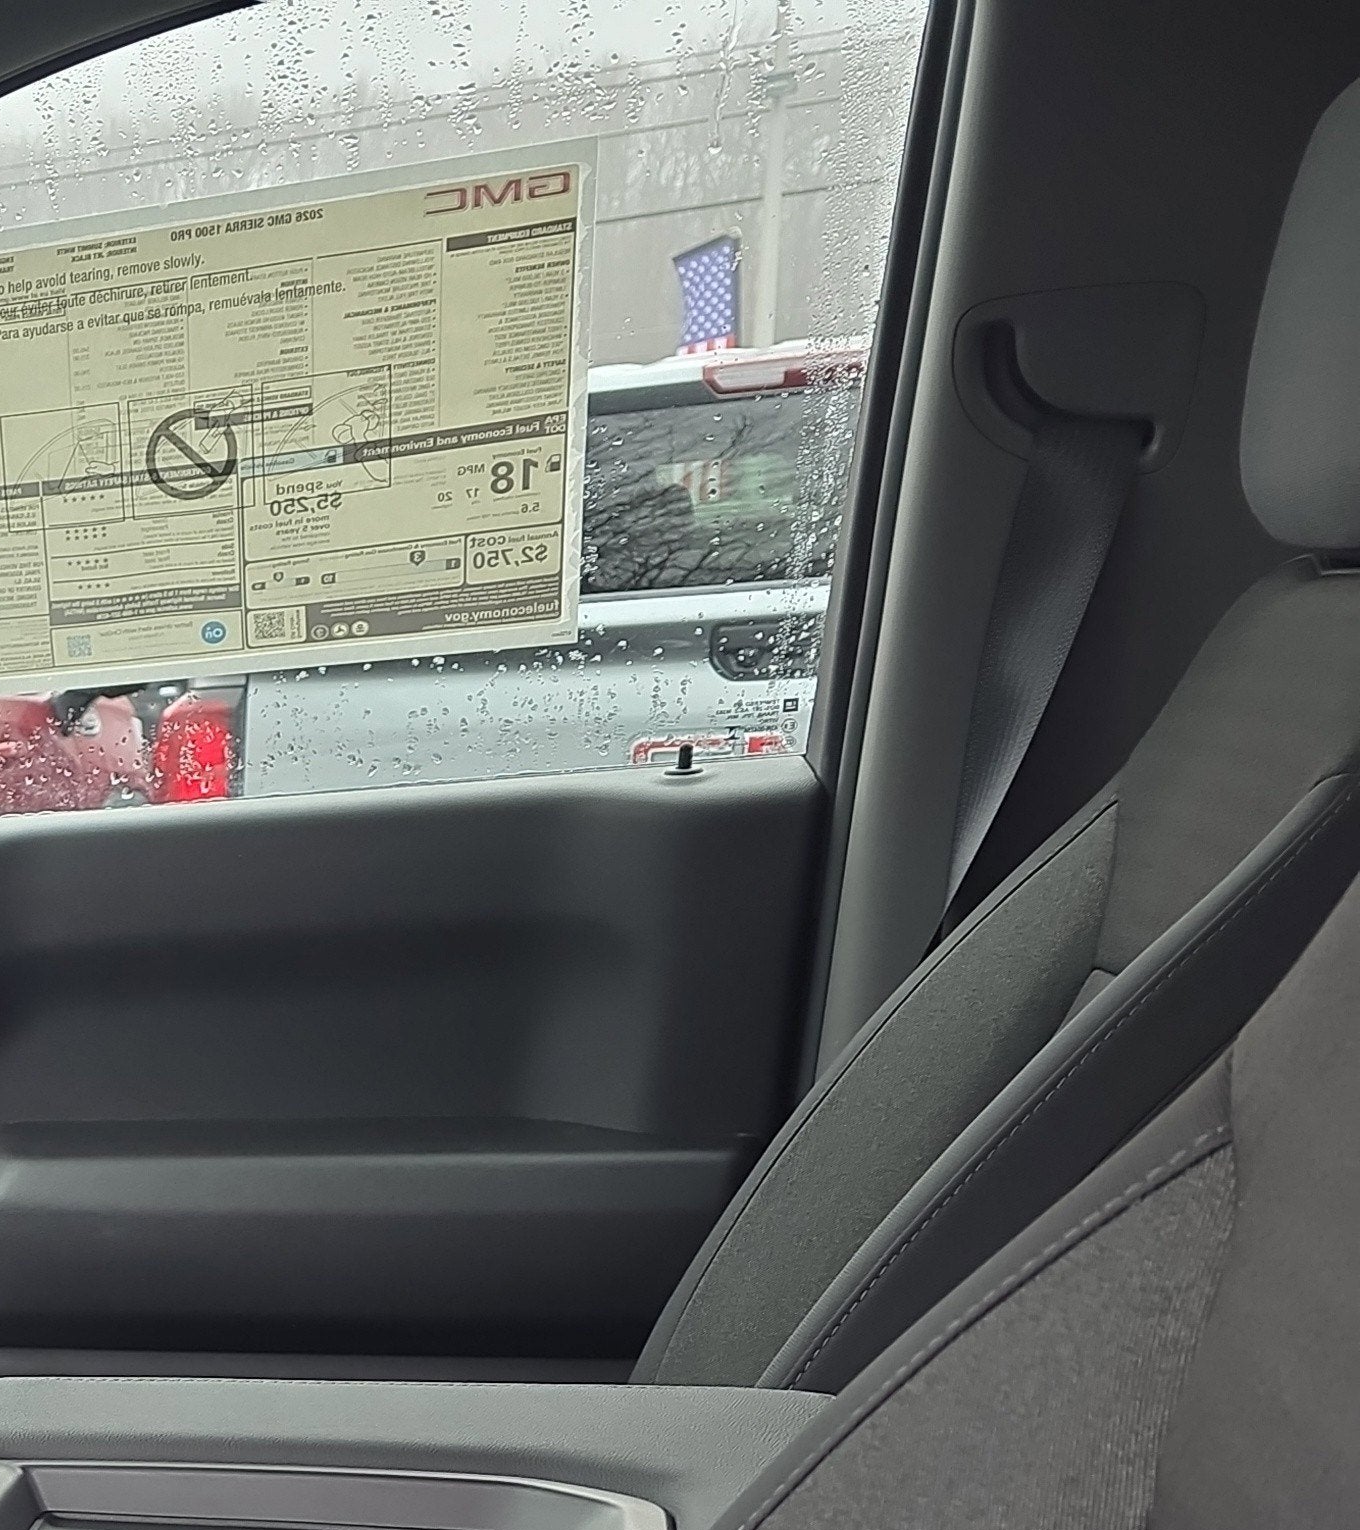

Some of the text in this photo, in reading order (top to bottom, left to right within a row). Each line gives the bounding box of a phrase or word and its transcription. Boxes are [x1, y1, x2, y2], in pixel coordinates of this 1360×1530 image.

[6, 277, 33, 295] help
[34, 272, 66, 289] avoid
[69, 266, 114, 286] tearing,
[116, 259, 160, 277] remove
[162, 251, 205, 272] slowly.
[20, 298, 53, 315] éviter
[56, 294, 86, 309] toute
[88, 285, 147, 306] déchirure,
[149, 278, 186, 295] retirer
[189, 268, 253, 289] lentement.
[21, 319, 74, 340] ayudarse
[86, 311, 120, 328] evitar
[121, 310, 144, 325] que
[146, 307, 160, 319] se
[163, 301, 205, 319] rompa,
[207, 289, 272, 311] remuévala
[274, 279, 346, 301] lentamente.
